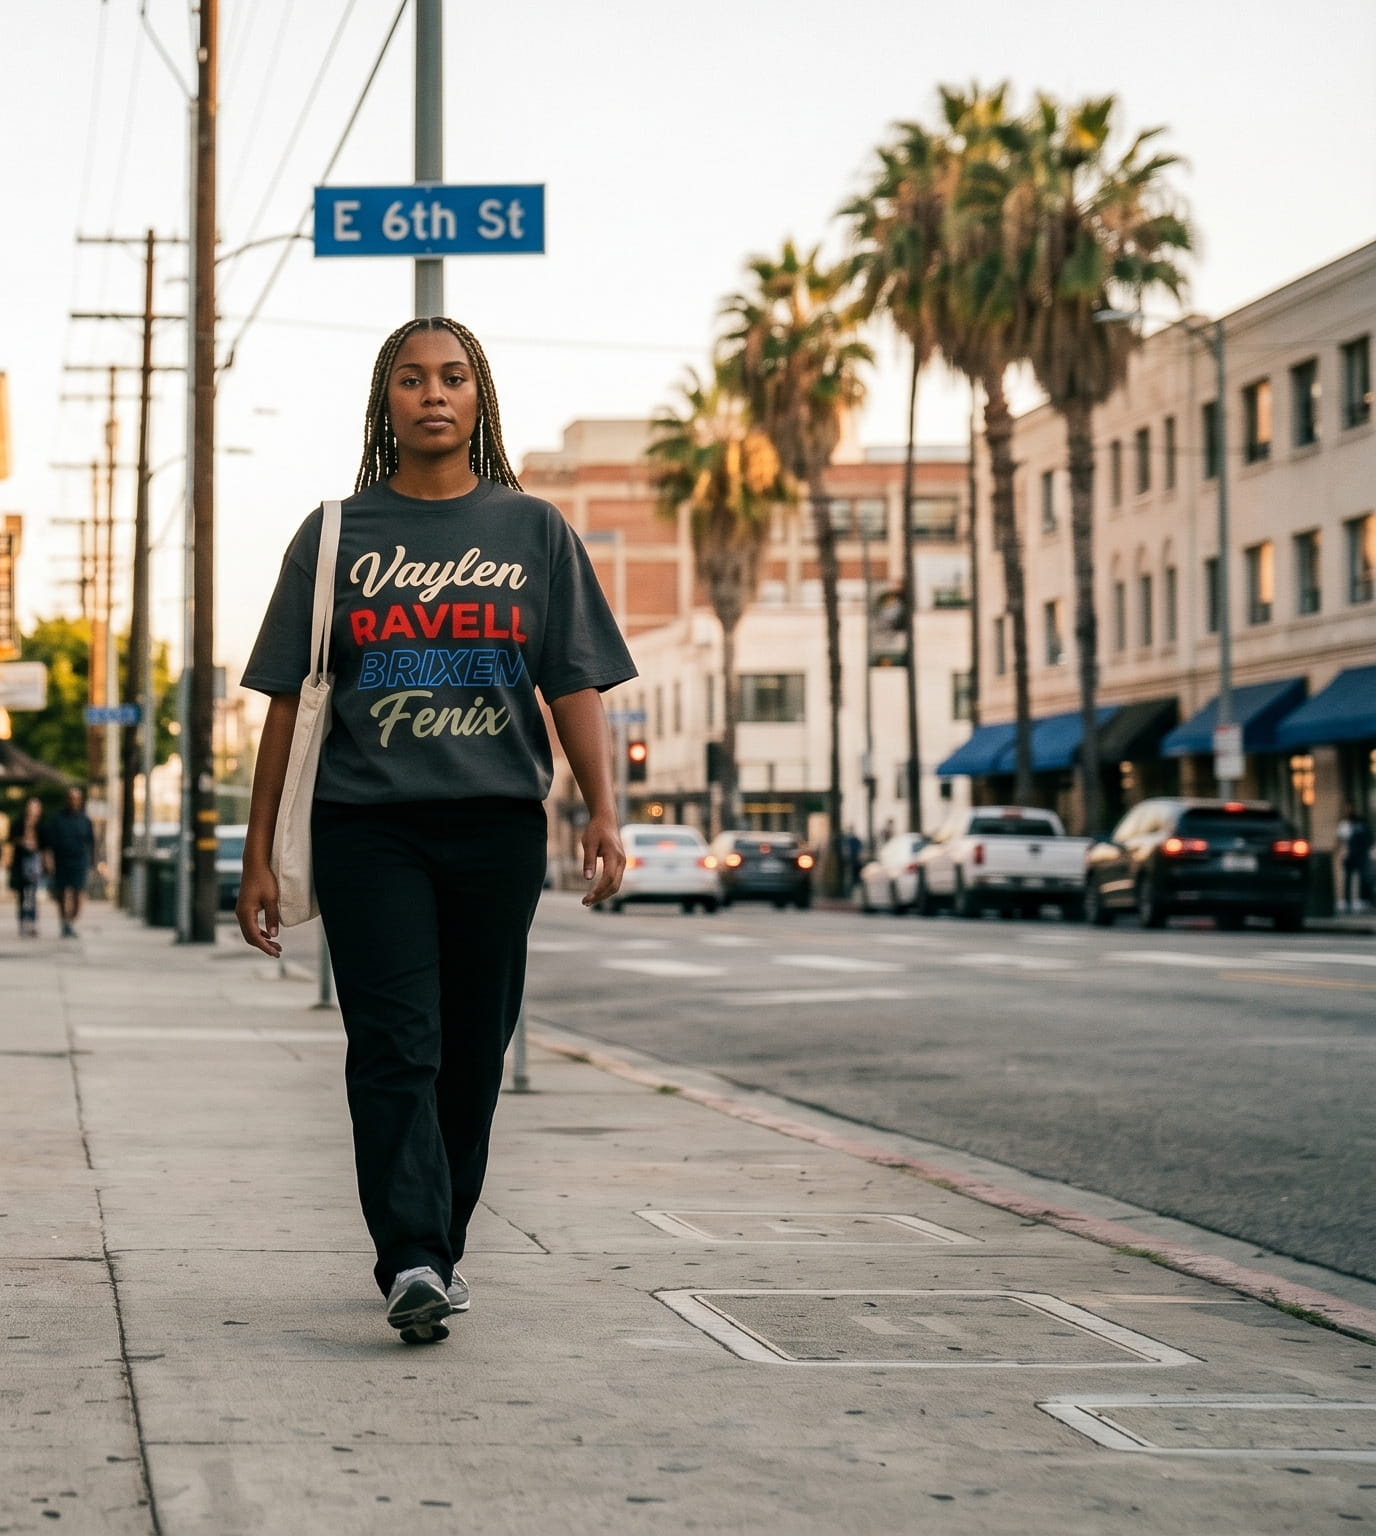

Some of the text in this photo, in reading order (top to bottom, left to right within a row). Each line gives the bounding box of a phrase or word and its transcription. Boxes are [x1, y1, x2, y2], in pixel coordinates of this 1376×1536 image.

[333, 199, 525, 242] E 6th St
[349, 545, 528, 603] Vaylen
[349, 602, 529, 646] RAVELL
[357, 648, 525, 691] BRIXEN
[369, 689, 512, 748] Fenix
